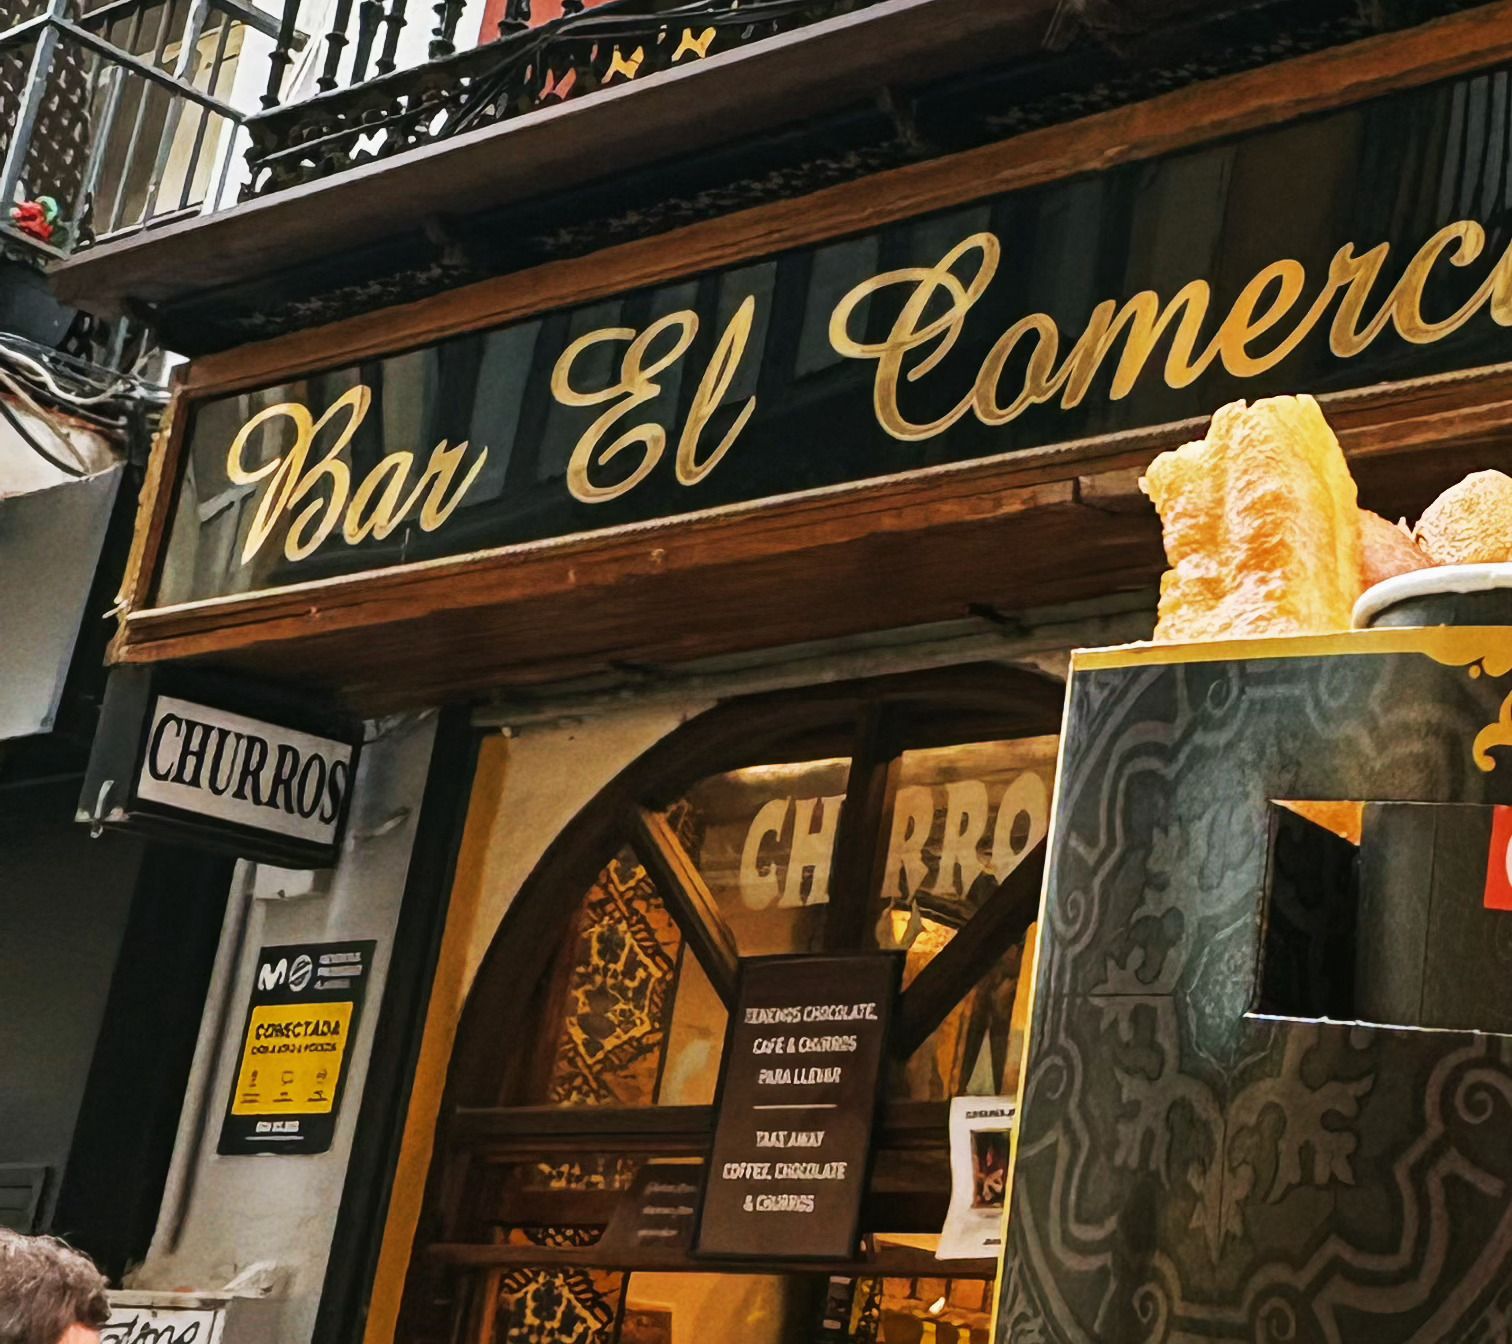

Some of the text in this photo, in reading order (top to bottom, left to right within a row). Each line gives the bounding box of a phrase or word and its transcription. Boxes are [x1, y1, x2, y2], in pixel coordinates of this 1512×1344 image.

[227, 385, 488, 566] Bar
[550, 294, 757, 504] El
[147, 712, 349, 825] CHURROS
